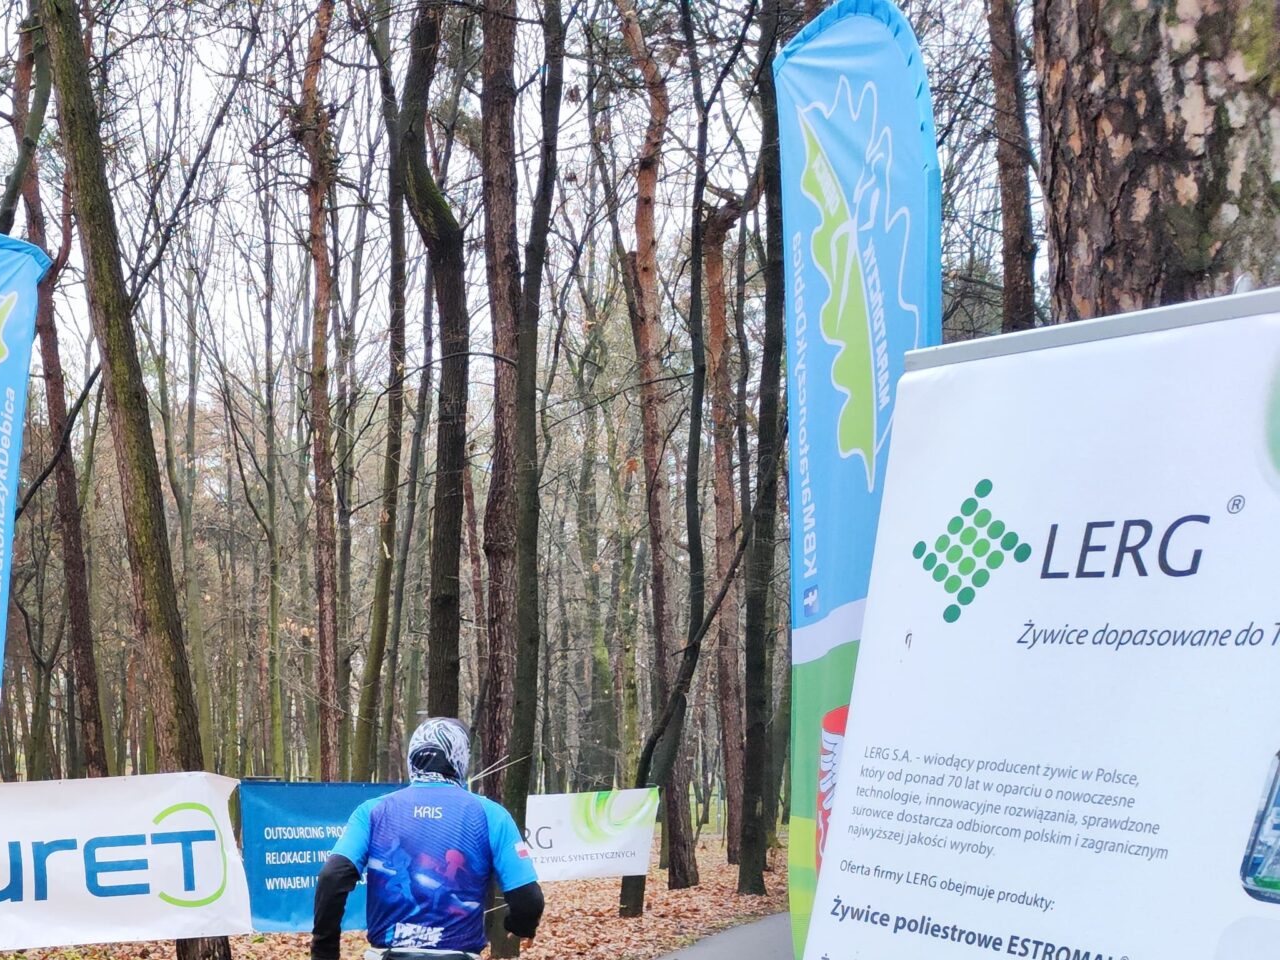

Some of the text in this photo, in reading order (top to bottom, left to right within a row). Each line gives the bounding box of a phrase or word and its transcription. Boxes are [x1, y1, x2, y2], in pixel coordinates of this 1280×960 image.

[1040, 514, 1211, 579] LERG
[1017, 619, 1089, 650] Żywice
[1091, 622, 1232, 651] dopasowane
[1234, 621, 1265, 646] do
[864, 746, 890, 760] LERG
[891, 748, 912, 763] S.A.
[924, 753, 975, 771] wiodący
[976, 758, 1041, 776] producent
[1042, 765, 1078, 781] żywic
[1081, 770, 1093, 781] w
[1095, 767, 1140, 787] Polsce,
[859, 765, 1136, 808] który od ponad 70 lat w oparciu o nowoczesne
[413, 805, 443, 819] KRIS
[856, 785, 1161, 835] technologie, innowacyjne rozwiązania, sprawdzone
[264, 826, 325, 840] OUTSOURCING
[847, 824, 996, 858] najwyższej jakości wyroby.
[851, 805, 1169, 861] surowce dostarcza odbiorcom polskim i zagranicznym
[265, 851, 311, 865] RELOKACJE
[312, 851, 316, 863] I
[568, 850, 636, 862] SYNTETYCZNYCH
[265, 875, 310, 890] WYNAJEM
[311, 876, 315, 888] I
[839, 859, 1056, 912] Oferta firmy LERG obejmuje produkty:
[830, 895, 890, 927] Żywice
[893, 915, 1004, 952] poliestrowe
